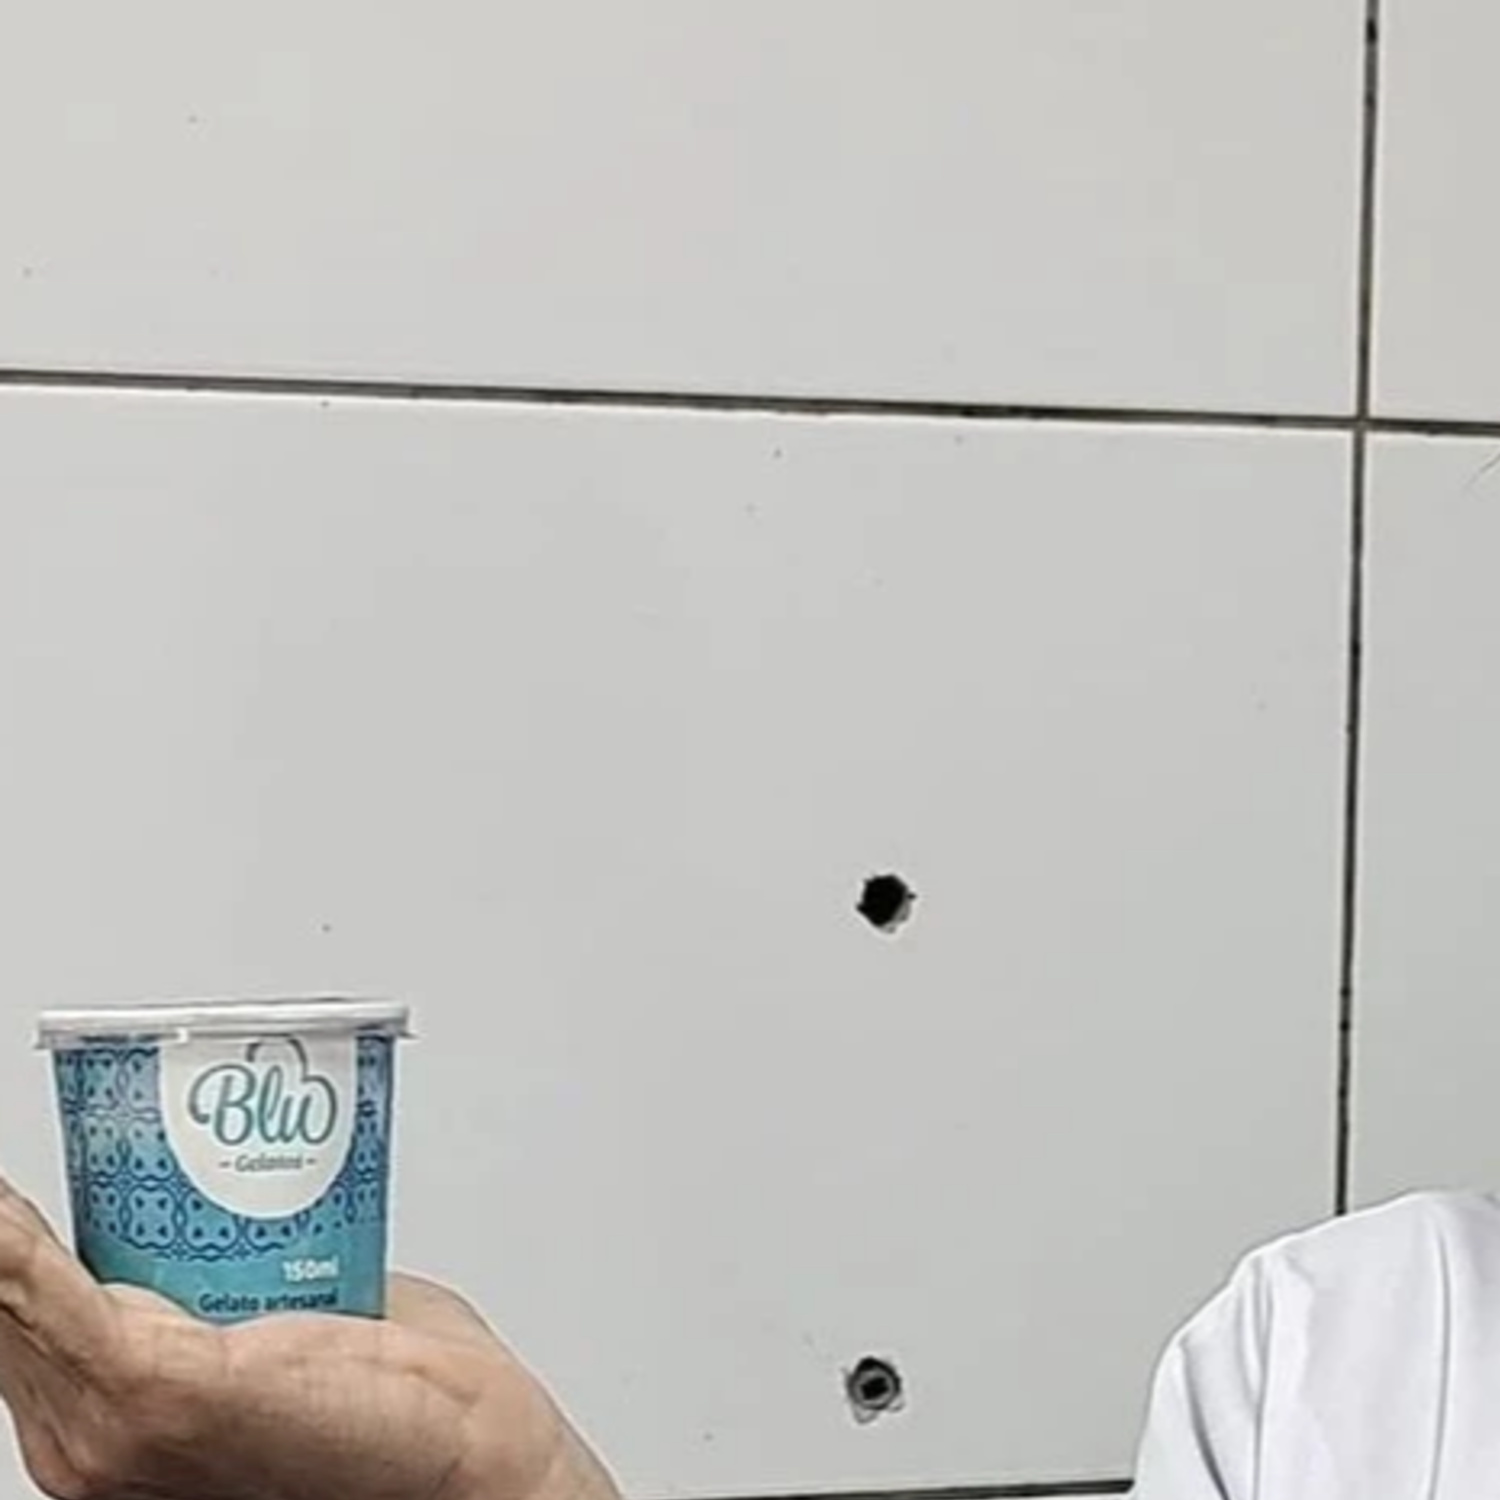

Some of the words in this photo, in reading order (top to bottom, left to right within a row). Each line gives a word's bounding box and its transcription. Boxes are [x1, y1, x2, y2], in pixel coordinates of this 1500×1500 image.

[188, 1061, 337, 1146] Blu
[282, 1255, 339, 1282] 150ml
[199, 1293, 260, 1313] Gelato
[264, 1287, 338, 1311] artesanal
